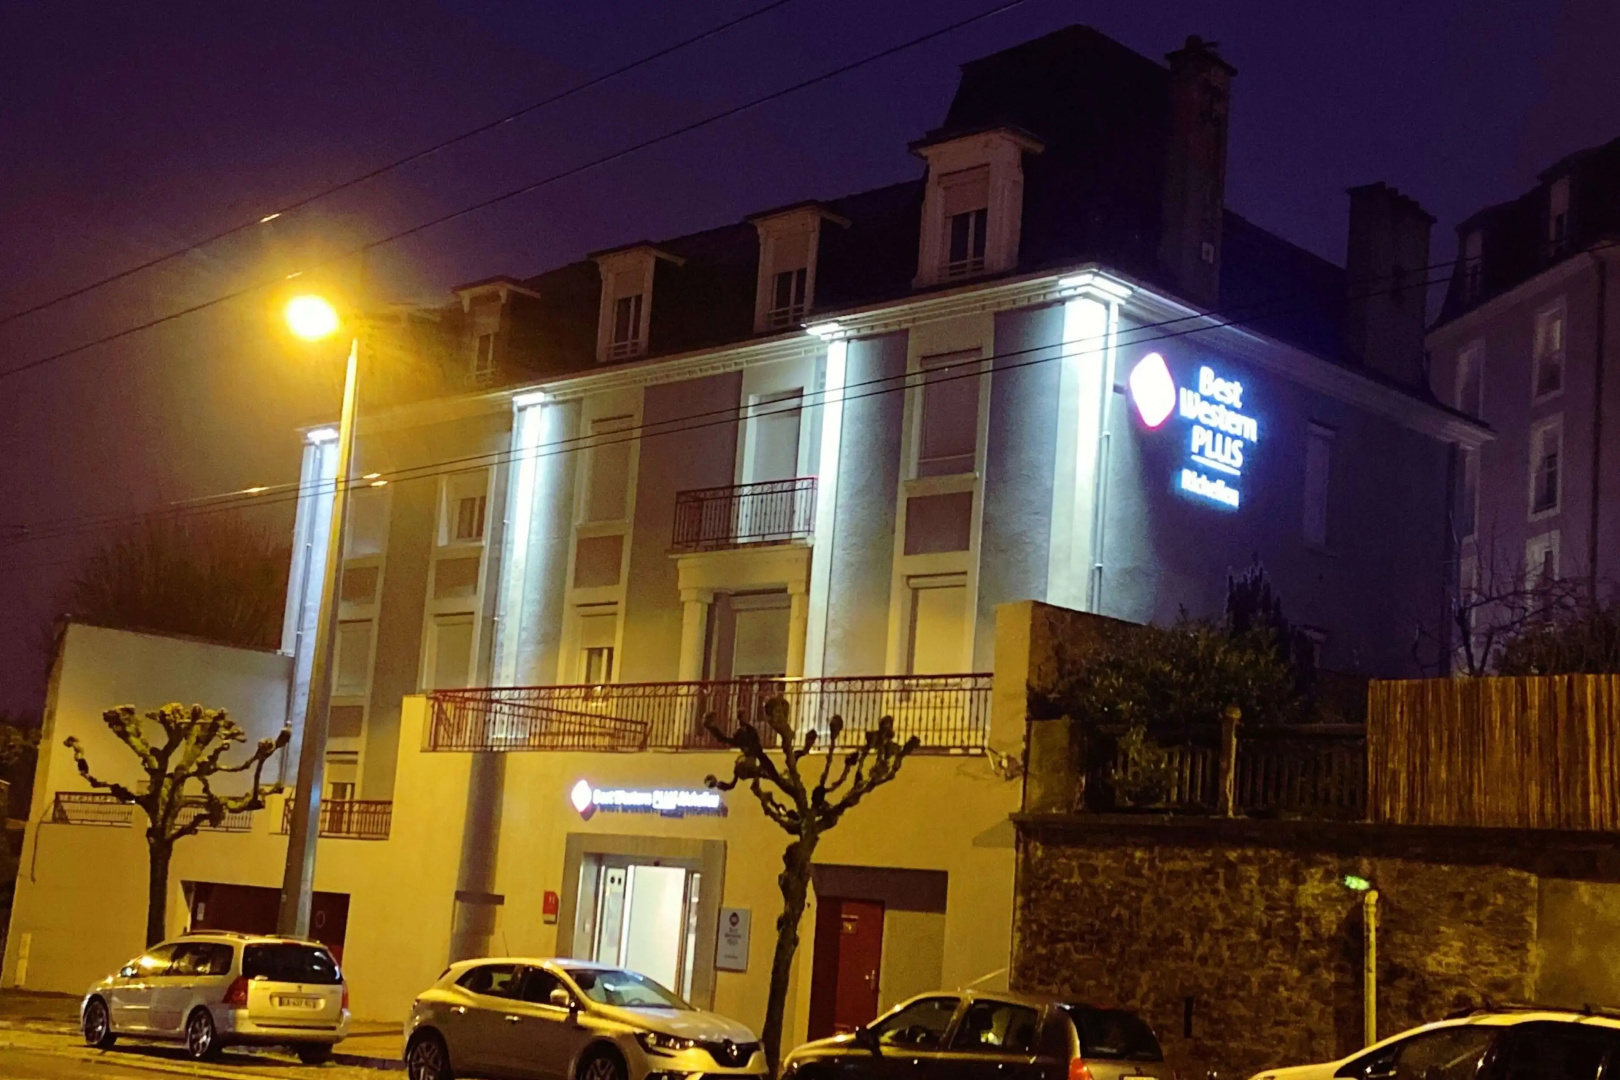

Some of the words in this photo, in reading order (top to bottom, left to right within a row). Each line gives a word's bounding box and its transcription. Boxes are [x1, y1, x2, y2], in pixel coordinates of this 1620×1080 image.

[1199, 366, 1243, 409] Best
[1179, 386, 1257, 442] Western
[1191, 424, 1243, 468] PLUS
